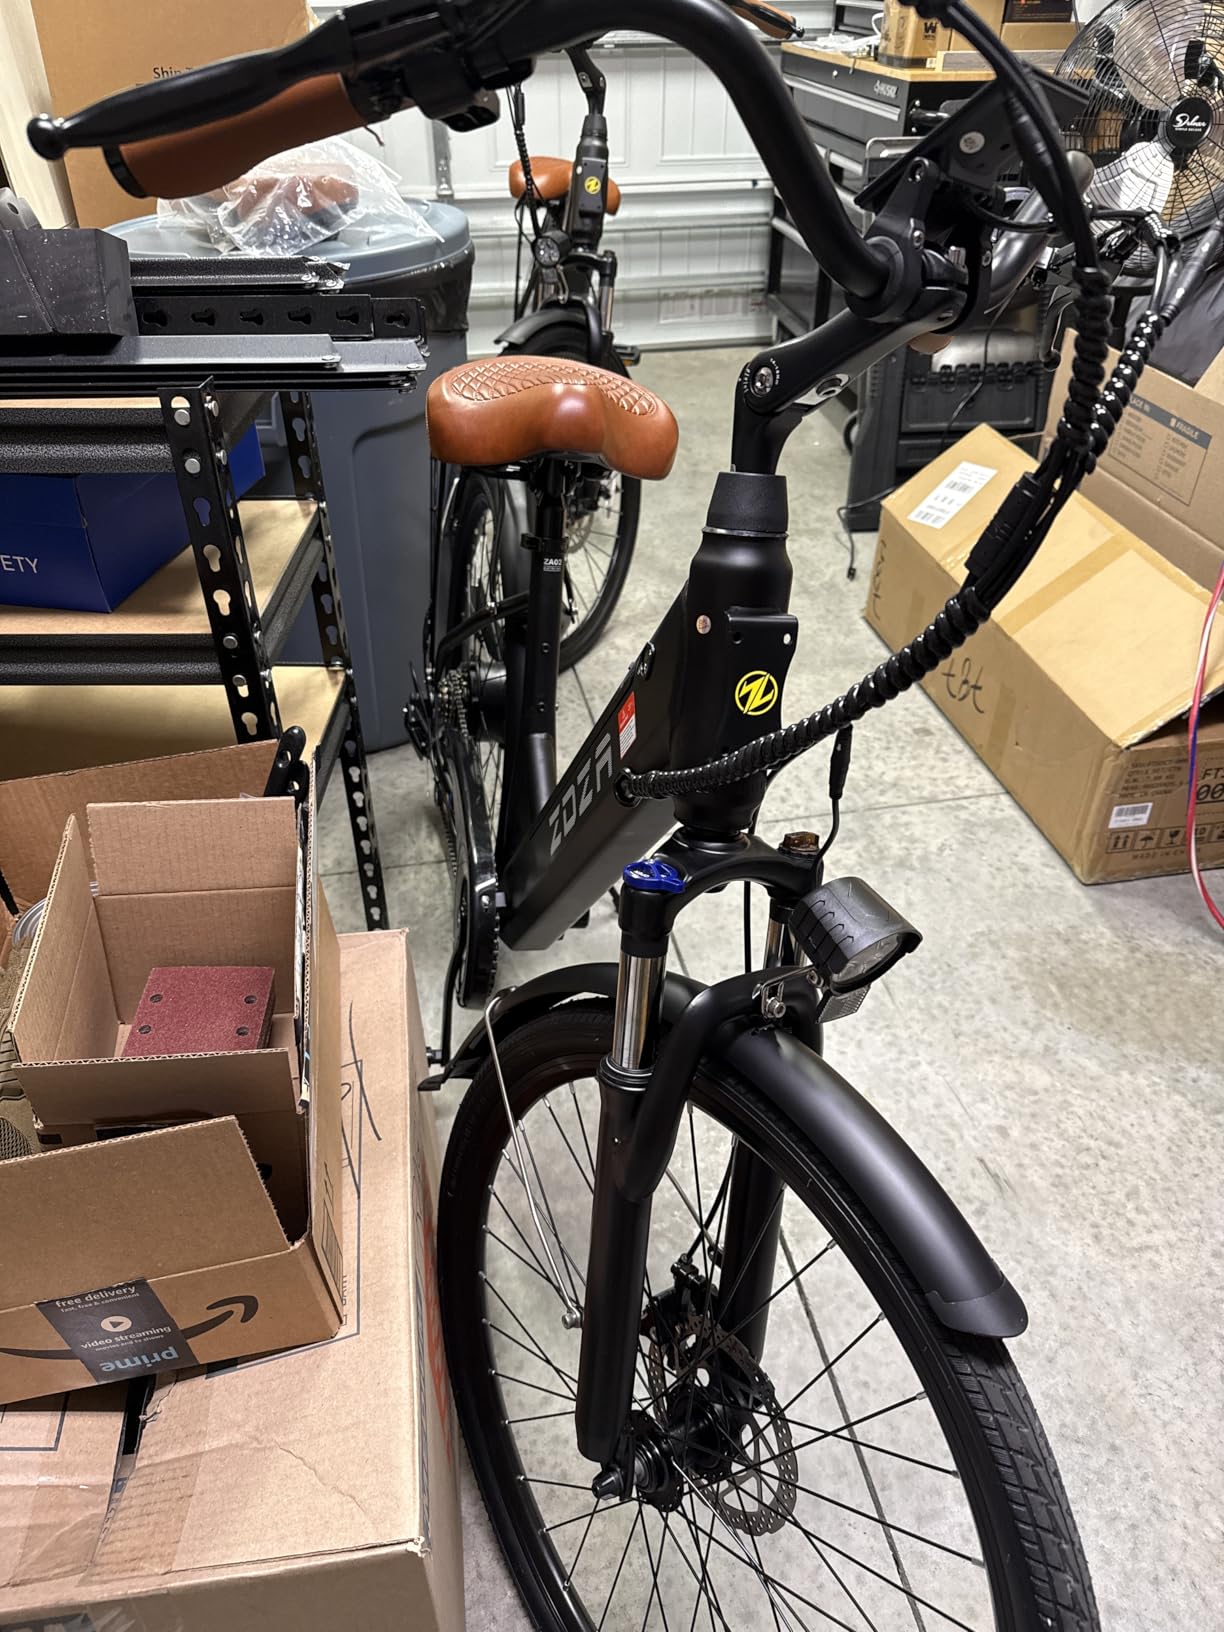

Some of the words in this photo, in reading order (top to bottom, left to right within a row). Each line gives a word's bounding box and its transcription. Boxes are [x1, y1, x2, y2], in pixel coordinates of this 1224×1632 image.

[0, 554, 38, 574] ETY
[55, 1297, 81, 1309] free
[84, 1285, 137, 1302] delivery
[81, 1337, 113, 1350] video
[114, 1325, 172, 1342] streaming
[99, 1345, 179, 1373] prime
